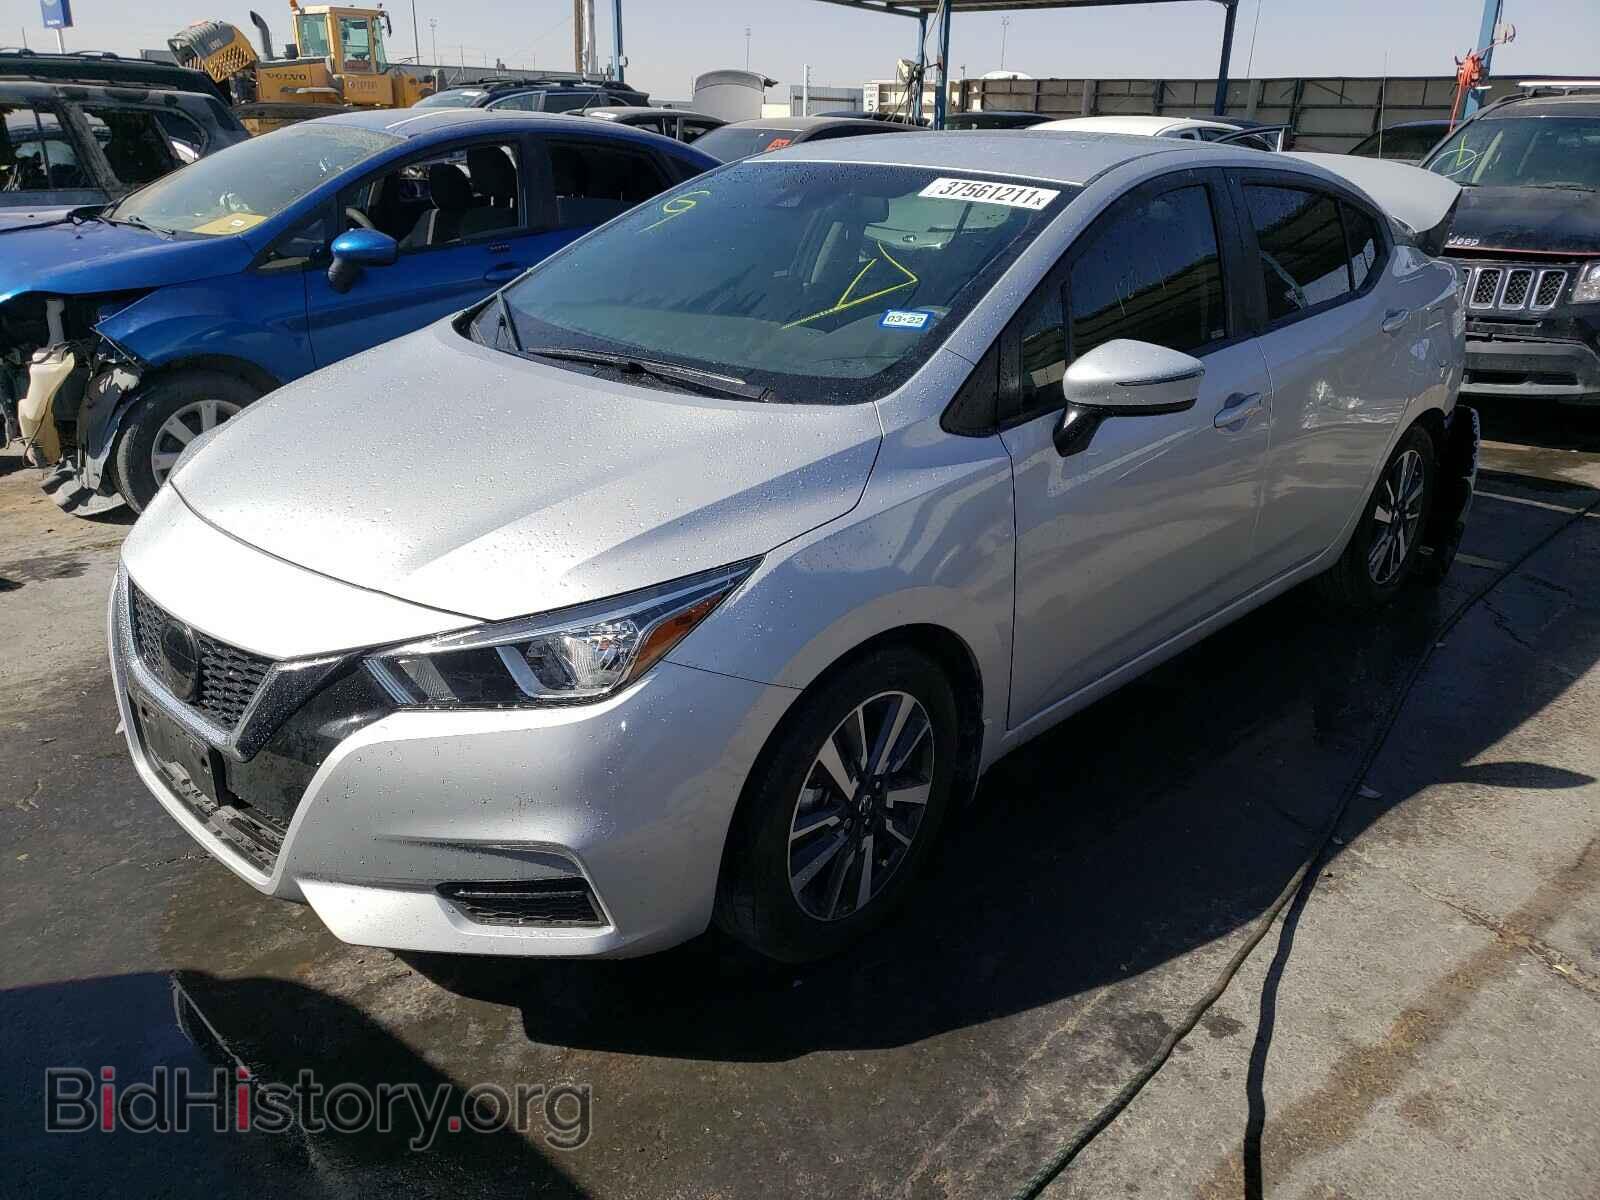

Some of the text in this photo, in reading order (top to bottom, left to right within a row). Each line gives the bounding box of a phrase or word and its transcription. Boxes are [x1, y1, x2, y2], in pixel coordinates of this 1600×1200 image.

[264, 72, 307, 81] VOLVO
[868, 100, 874, 111] 5
[1448, 234, 1479, 246] Jeep
